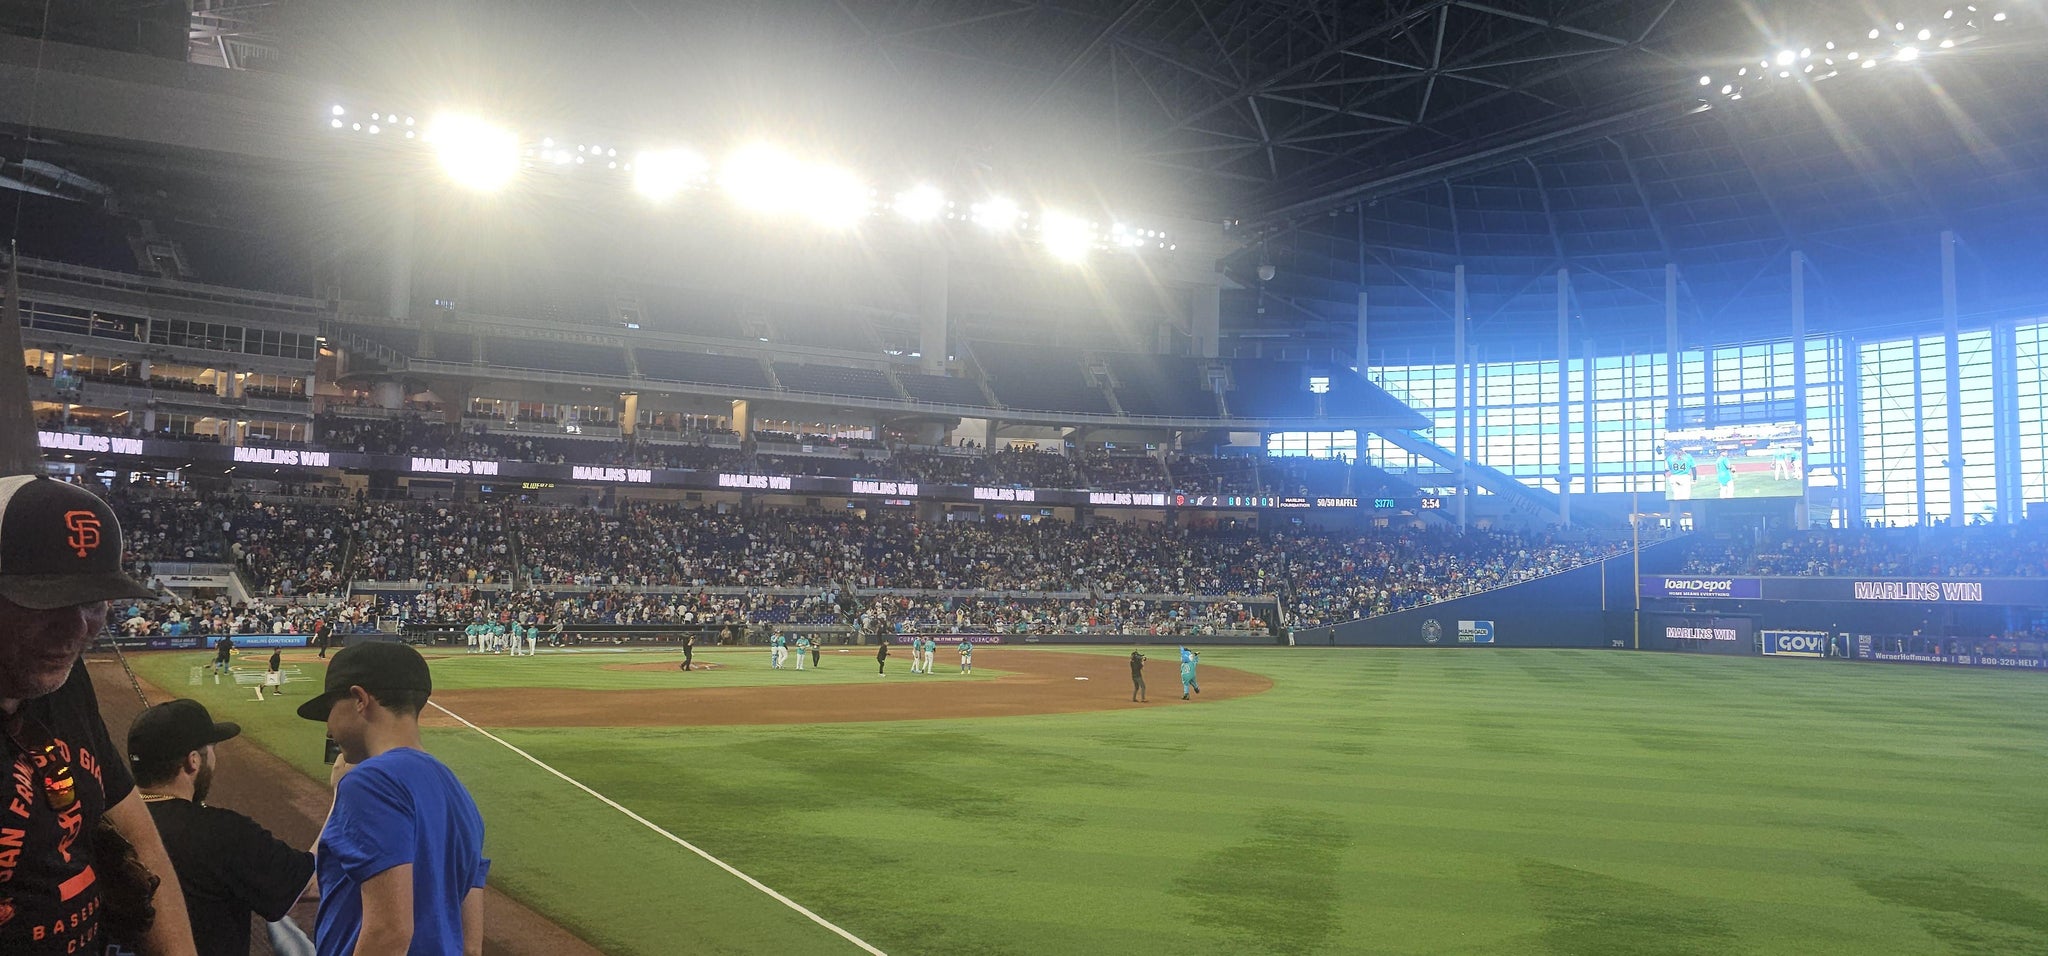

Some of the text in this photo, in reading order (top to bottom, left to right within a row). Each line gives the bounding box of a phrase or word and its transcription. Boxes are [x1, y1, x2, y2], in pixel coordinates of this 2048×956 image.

[38, 431, 143, 455] MARLINS WIN
[234, 447, 330, 467] MARLINS WIN
[411, 458, 498, 475] MARLINS WIN
[1672, 462, 1686, 471] 84
[573, 466, 651, 483] MARLINS WIN
[719, 474, 791, 490] MARLINS WIN
[852, 481, 918, 496] MARLINS WIN
[974, 487, 1035, 502] MARLINS WIN
[1089, 492, 1152, 506] MARLINS WIN
[1212, 496, 1218, 506] 2
[1268, 497, 1274, 507] 3
[1317, 498, 1358, 508] 50/50 RAFFLE
[1421, 498, 1440, 509] 3:54
[64, 510, 101, 558] SF
[1664, 578, 1733, 592] loanDepot
[1854, 582, 1982, 602] MARLINS WIN
[1666, 627, 1736, 640] MARLINS WIN
[1981, 657, 2039, 667] 800-320-HELP
